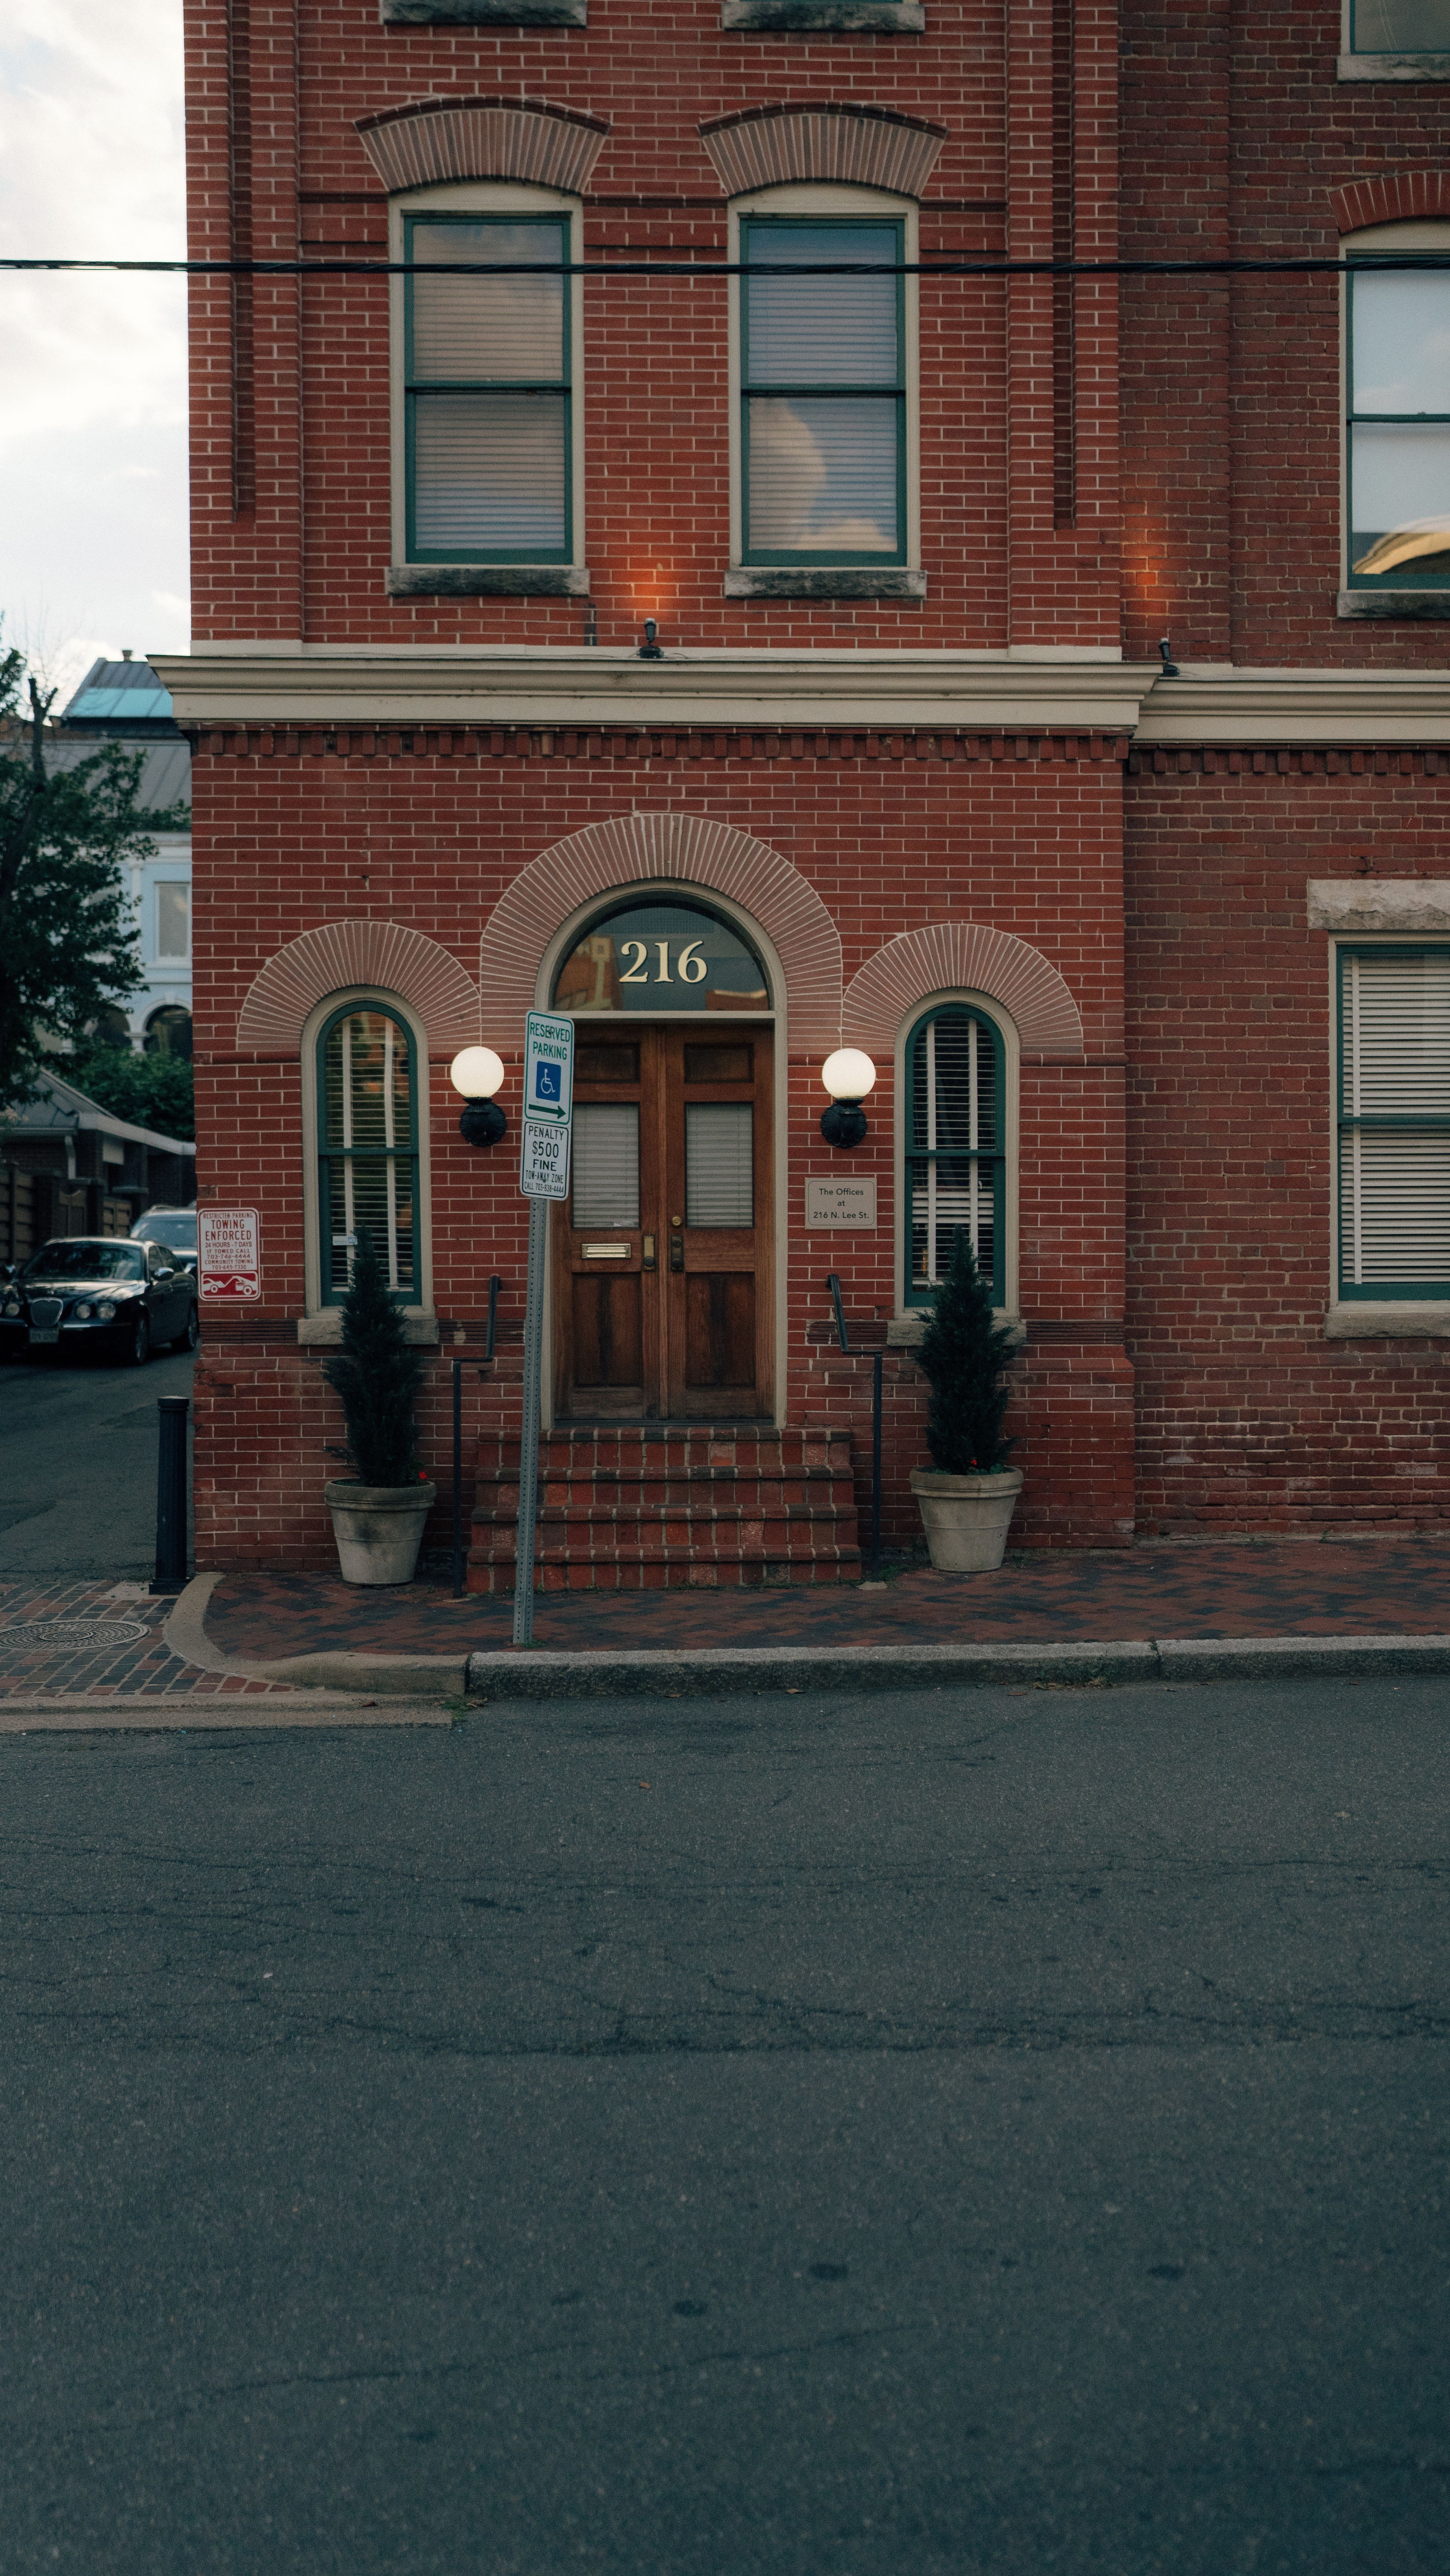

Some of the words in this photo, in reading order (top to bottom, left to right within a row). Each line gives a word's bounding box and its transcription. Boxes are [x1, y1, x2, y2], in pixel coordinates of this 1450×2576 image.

[619, 940, 707, 983] 216
[530, 1022, 570, 1042] RESERVED
[533, 1041, 567, 1060] PARKING
[529, 1125, 564, 1141] PENALTY
[532, 1141, 559, 1158] $500
[533, 1159, 557, 1171] FINE
[526, 1170, 549, 1182] TOW-AWAY
[552, 1173, 563, 1184] ZONE
[524, 1181, 534, 1190] CALL
[536, 1183, 564, 1193] 703-838-4444
[211, 1219, 244, 1229] TOWING
[205, 1230, 251, 1241] ENFORCED
